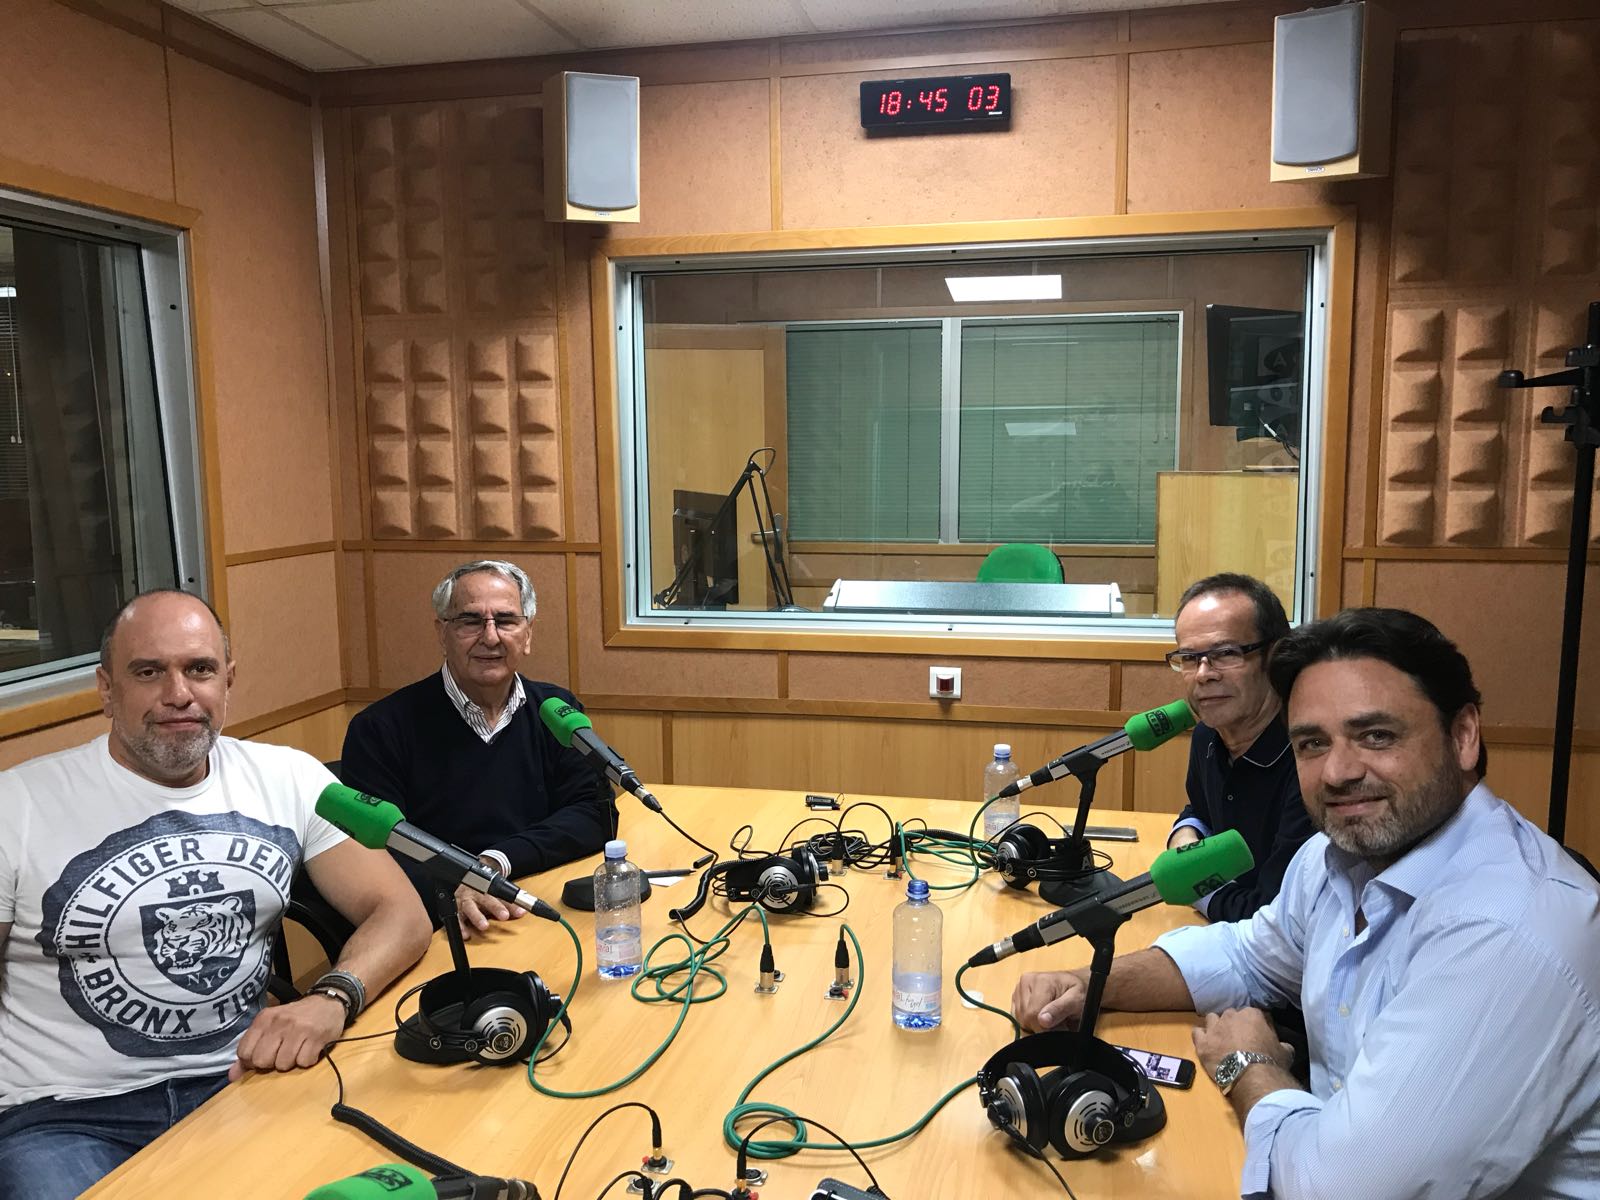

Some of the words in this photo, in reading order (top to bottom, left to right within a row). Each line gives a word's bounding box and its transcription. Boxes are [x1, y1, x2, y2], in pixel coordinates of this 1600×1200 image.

[880, 88, 948, 115] 18:45
[967, 85, 1000, 111] 03
[65, 837, 205, 949] HILFIGER
[227, 837, 291, 899] DENI
[83, 967, 197, 1034] BRONX
[187, 966, 230, 989] NYC
